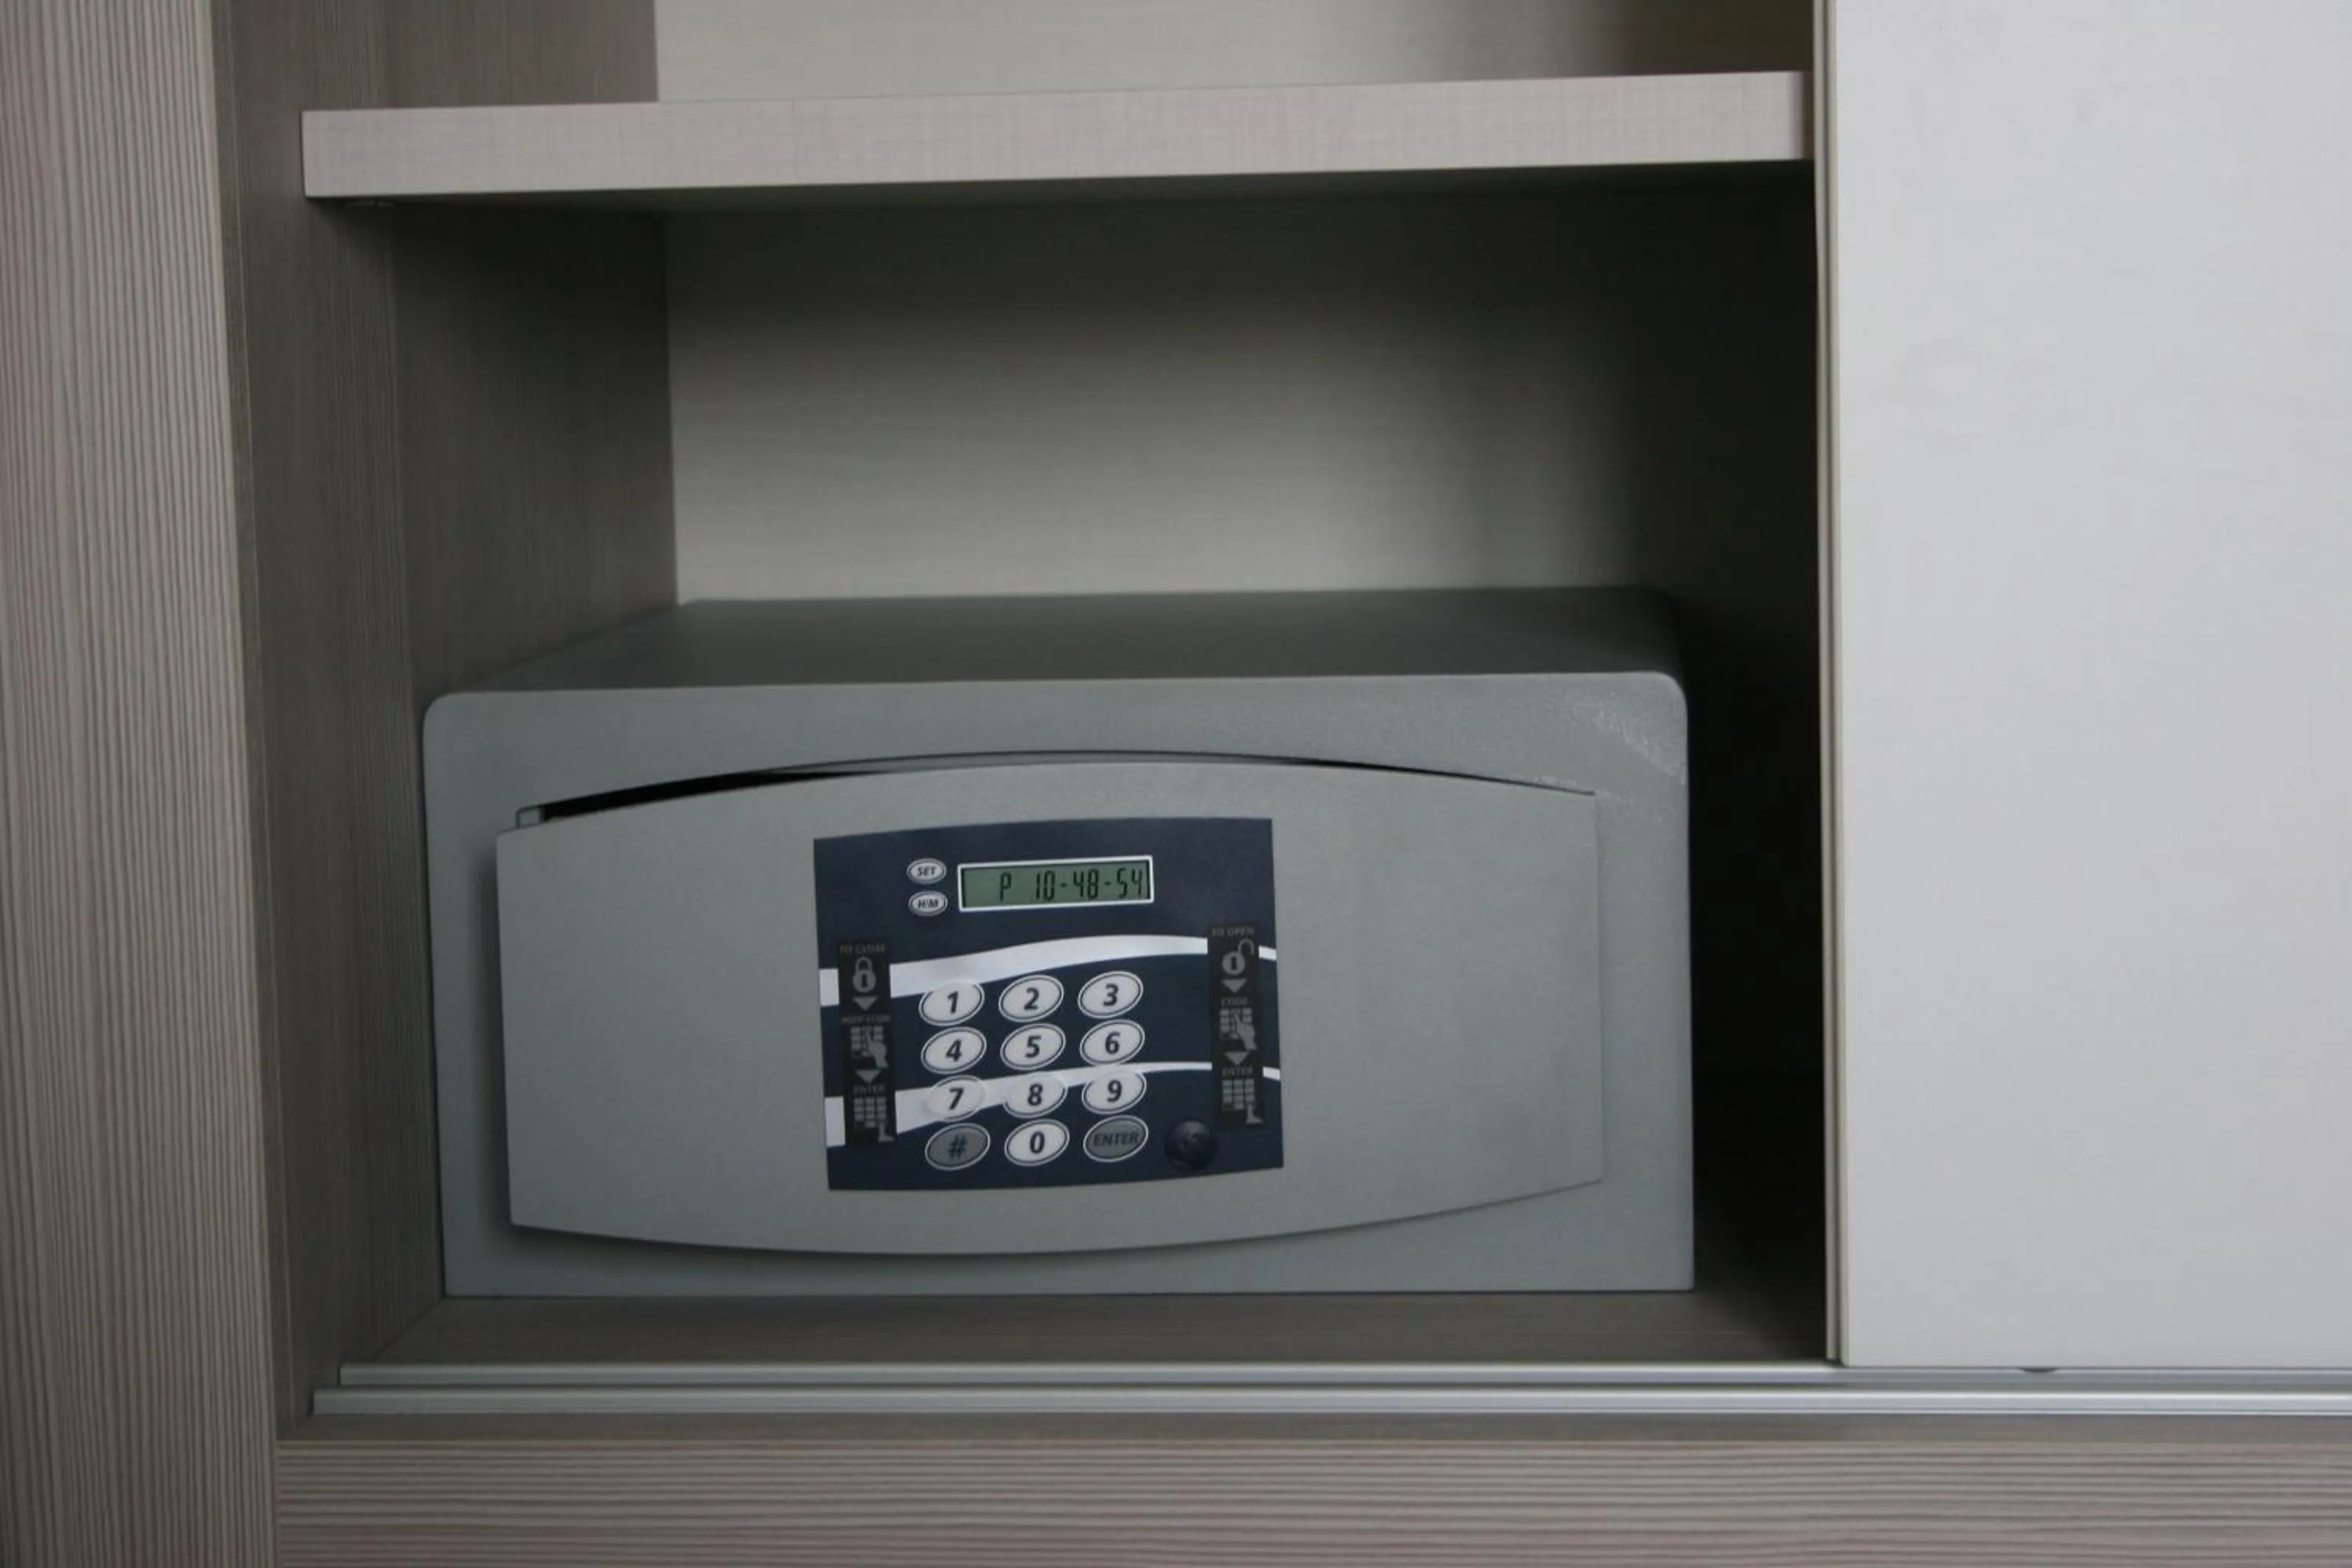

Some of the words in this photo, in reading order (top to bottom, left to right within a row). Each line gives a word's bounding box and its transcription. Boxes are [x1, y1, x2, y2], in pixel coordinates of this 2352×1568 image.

[916, 866, 936, 878] SET
[1000, 872, 1012, 902] P
[1035, 867, 1143, 901] 10-48-54
[947, 990, 959, 1013] 1
[1023, 987, 1040, 1011] 2
[1103, 983, 1119, 1007] 3
[946, 1039, 963, 1062] 4
[1025, 1035, 1042, 1058] 5
[1105, 1031, 1120, 1054] 6
[949, 1087, 964, 1110] 7
[1027, 1083, 1044, 1106] 8
[1107, 1079, 1123, 1102] 9
[947, 1134, 968, 1158] #
[1029, 1131, 1046, 1155] 0
[1094, 1132, 1140, 1146] ENTER
